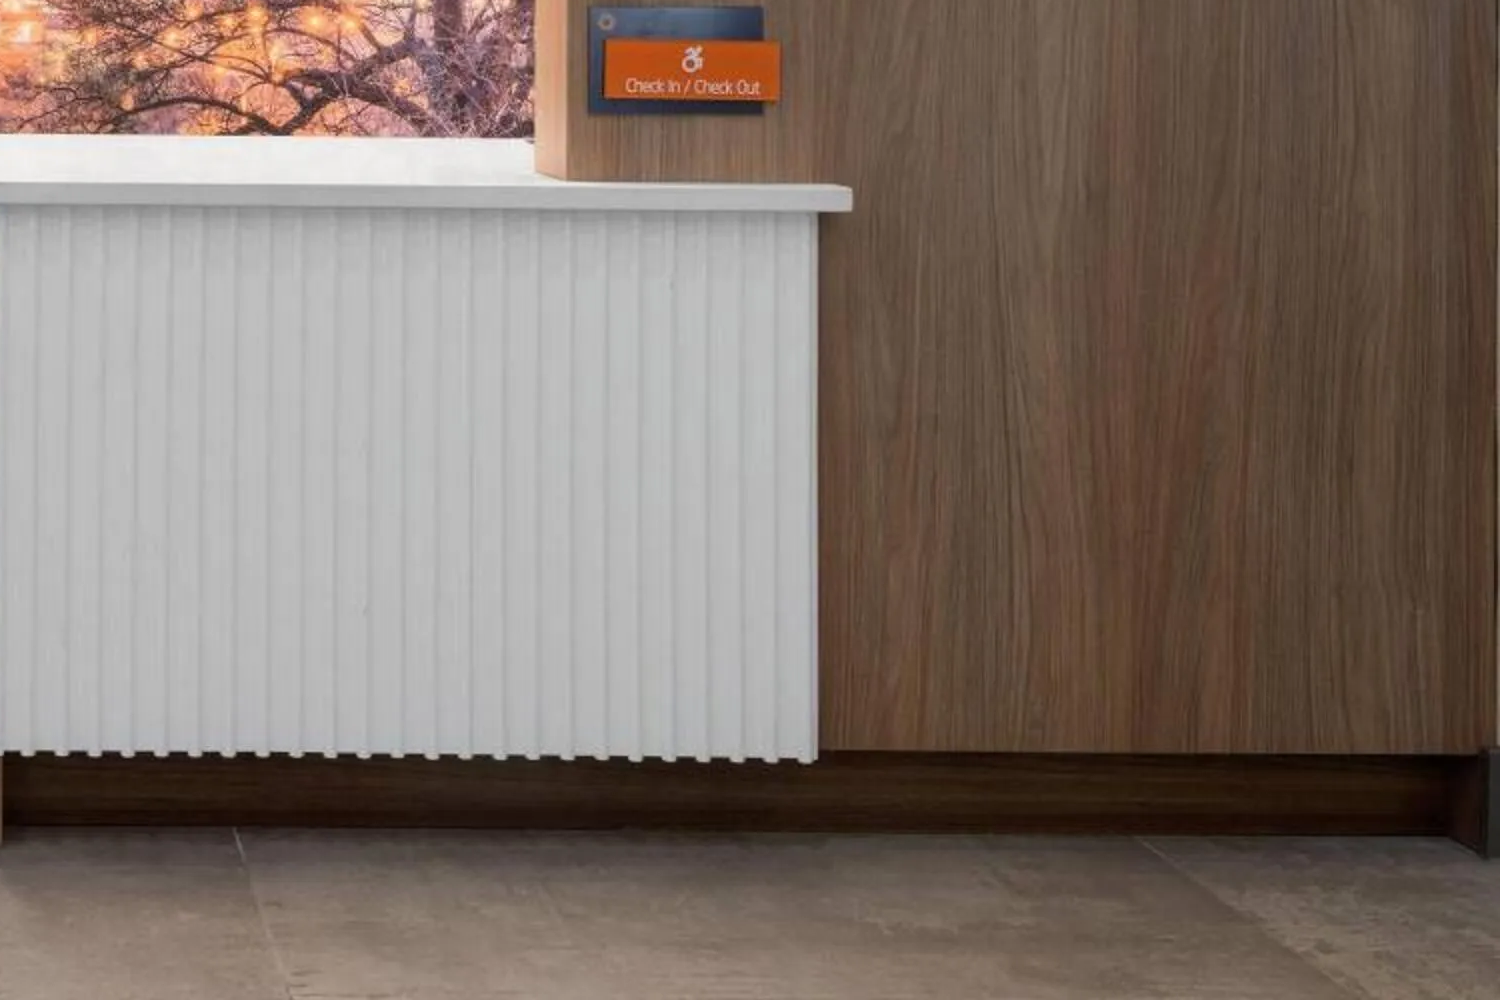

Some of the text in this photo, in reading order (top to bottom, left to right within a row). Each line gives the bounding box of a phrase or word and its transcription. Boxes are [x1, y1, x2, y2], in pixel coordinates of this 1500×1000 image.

[625, 77, 665, 94] Check
[667, 78, 681, 94] In
[694, 78, 733, 95] Check
[736, 79, 761, 96] Out
